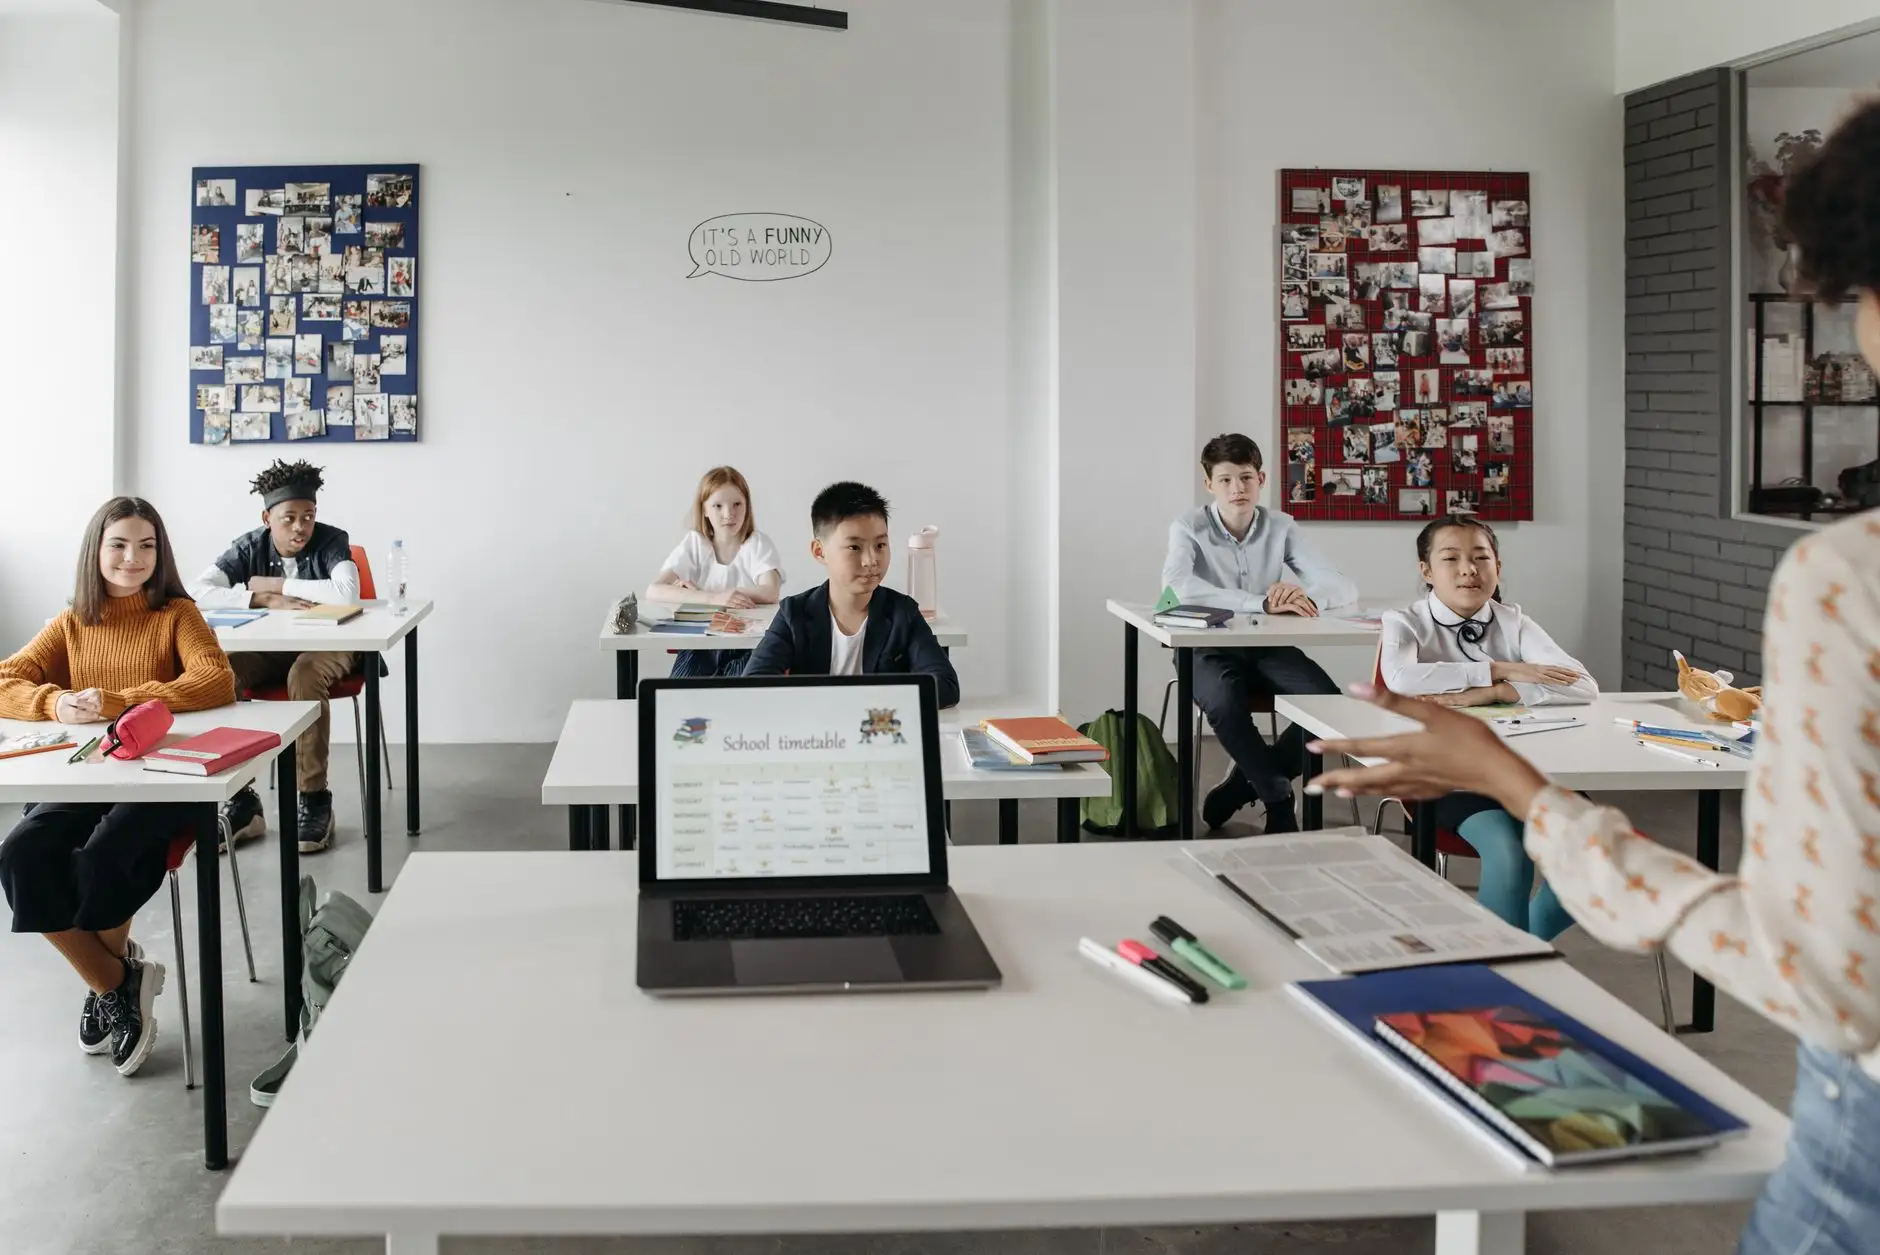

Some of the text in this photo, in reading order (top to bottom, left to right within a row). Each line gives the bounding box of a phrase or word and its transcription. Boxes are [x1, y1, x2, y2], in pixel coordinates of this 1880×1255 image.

[702, 227, 823, 246] IT'S A FUNNY
[705, 248, 811, 266] OLD WORLD
[723, 731, 846, 752] School timetable
